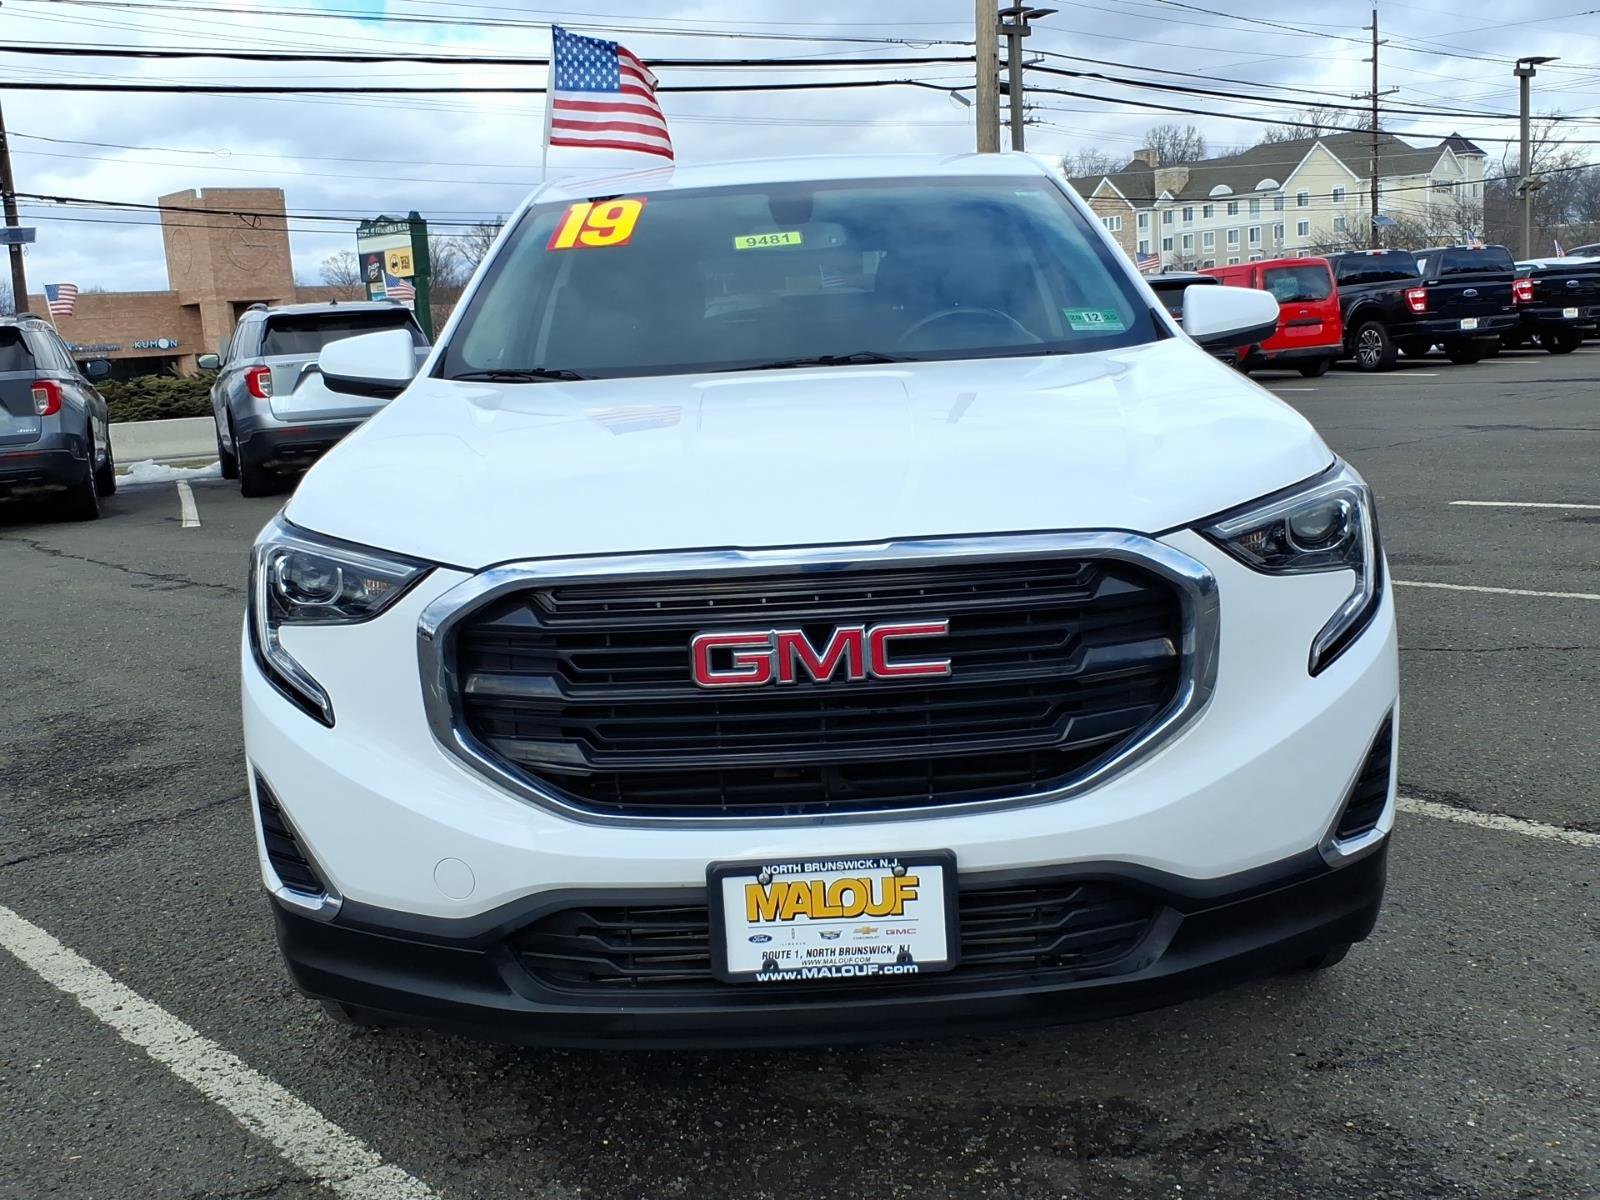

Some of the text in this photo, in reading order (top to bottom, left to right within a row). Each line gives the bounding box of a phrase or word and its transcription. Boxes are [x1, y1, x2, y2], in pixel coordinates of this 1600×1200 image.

[552, 199, 644, 249] 19
[745, 232, 791, 248] 9481
[1083, 312, 1102, 322] 12
[134, 338, 178, 350] KUMON
[691, 618, 952, 689] GMC
[762, 863, 801, 875] NORTH
[804, 859, 877, 872] BRUNSWICK,
[744, 875, 920, 924] MALOUF
[751, 935, 770, 943] Ford
[885, 927, 917, 936] GMC
[761, 949, 792, 960] ROUTE
[806, 947, 837, 958] NORTH
[838, 944, 896, 957] BRUNSWICK,
[801, 956, 871, 966] WWW.MALOUF.COM
[755, 963, 919, 982] www.MALOUF.com
